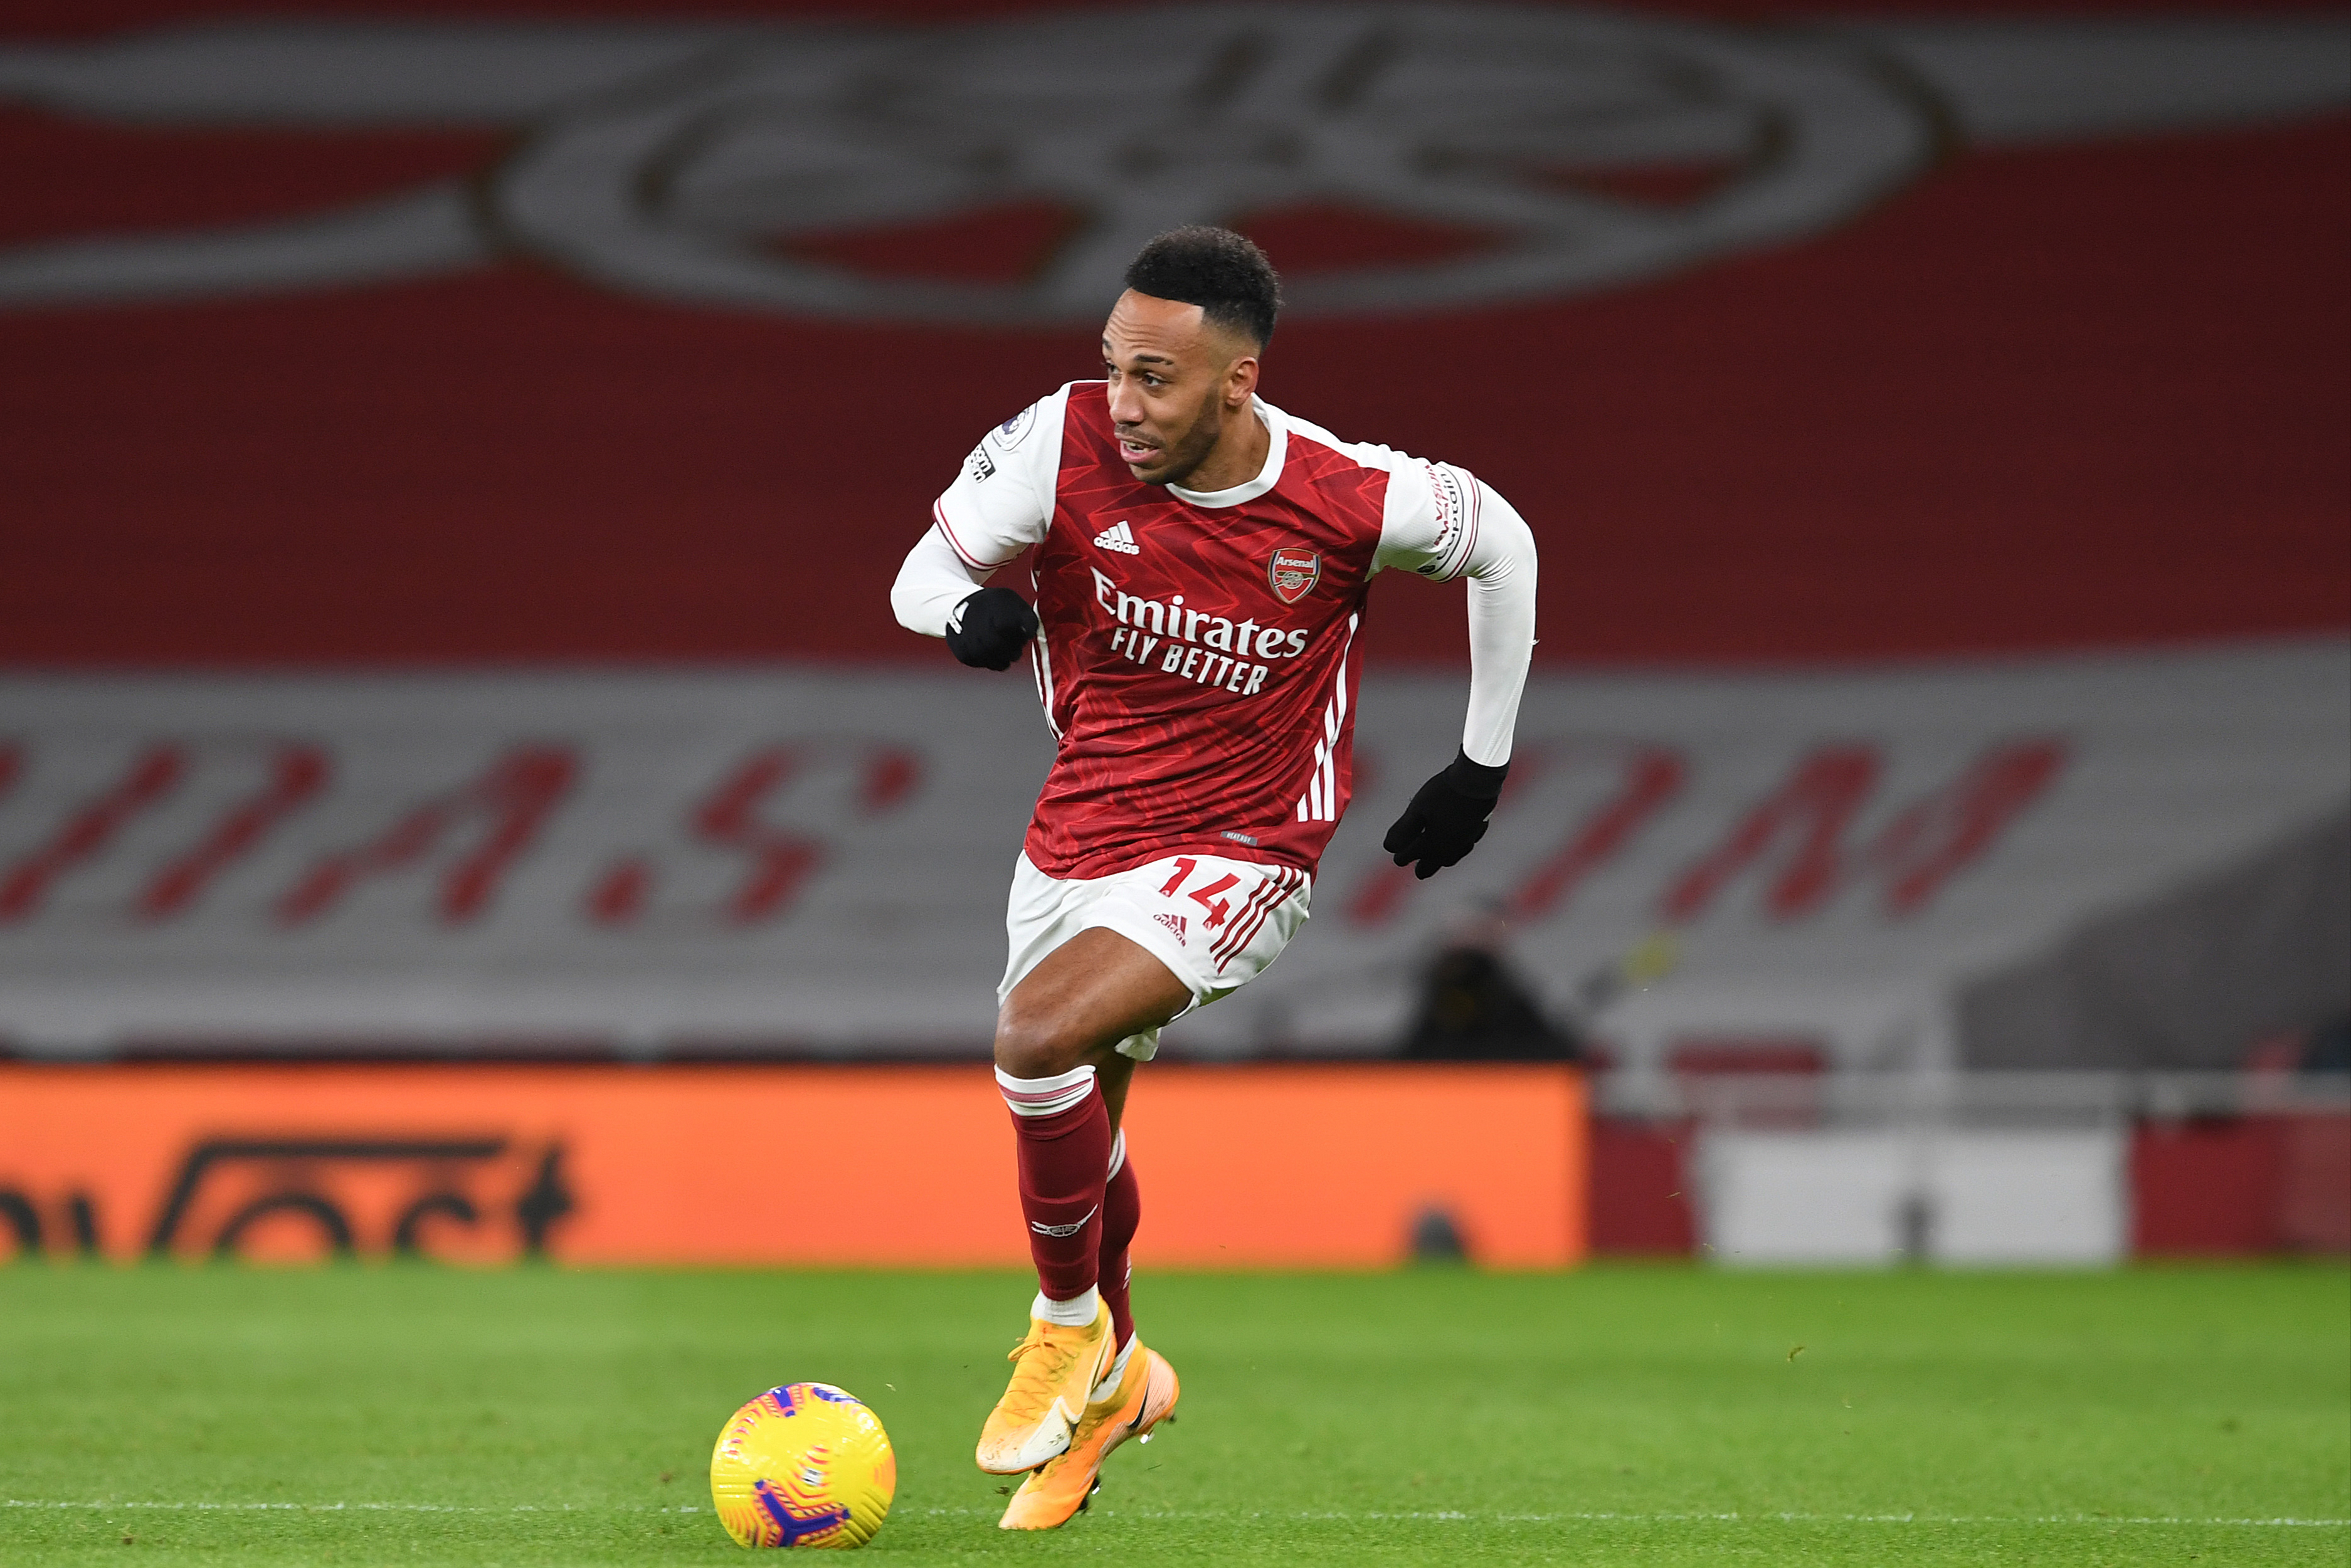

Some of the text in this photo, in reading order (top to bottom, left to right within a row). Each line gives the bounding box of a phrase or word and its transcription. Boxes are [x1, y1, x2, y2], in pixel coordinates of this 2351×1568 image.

[1094, 537, 1140, 555] adidas
[1276, 557, 1314, 568] Arsenal
[1090, 566, 1309, 659] Emirates
[1110, 627, 1268, 695] FLY BETTER
[1159, 856, 1242, 932] 14
[1153, 914, 1186, 947] adidas
